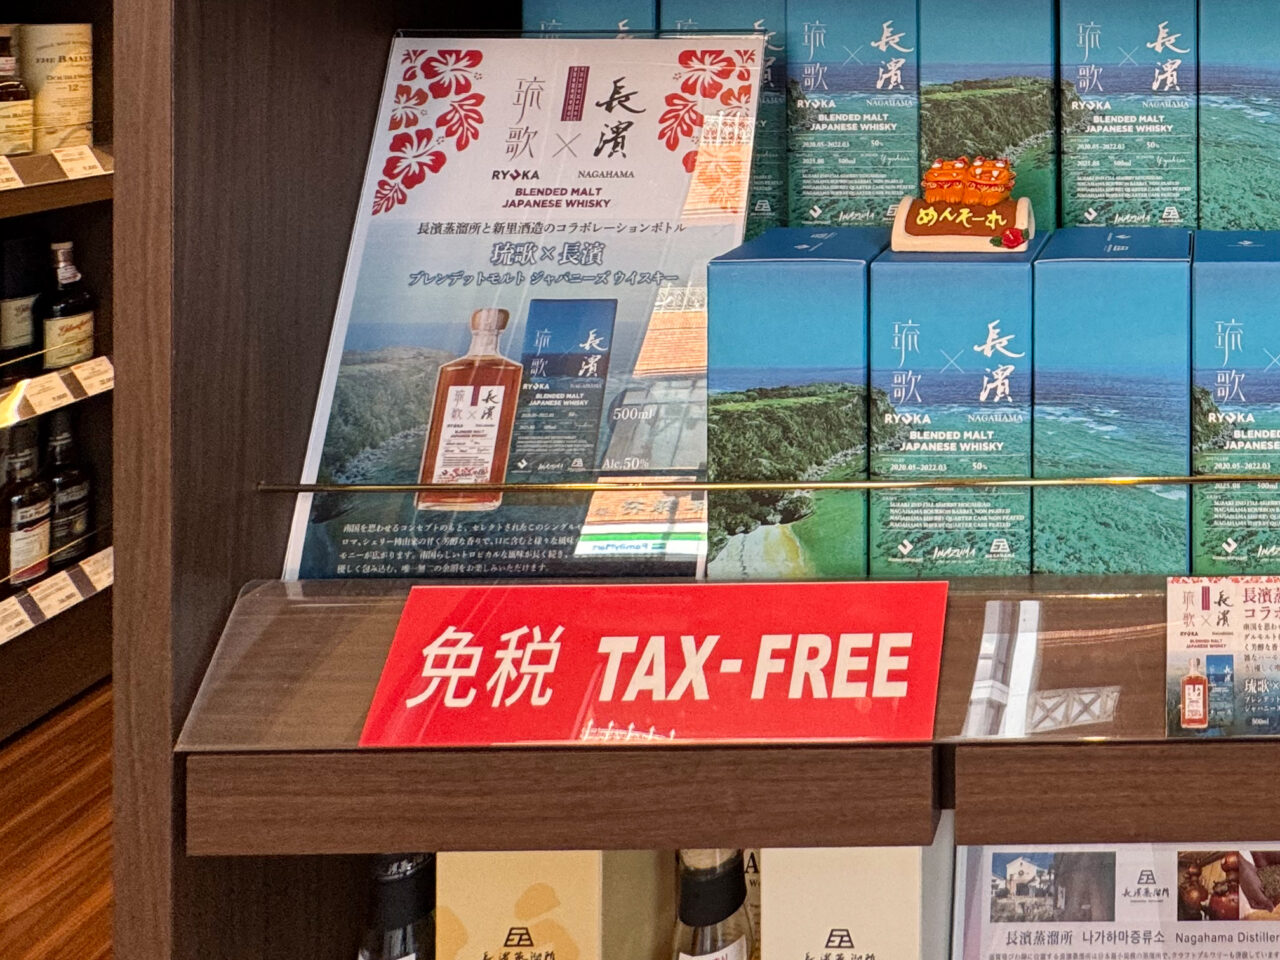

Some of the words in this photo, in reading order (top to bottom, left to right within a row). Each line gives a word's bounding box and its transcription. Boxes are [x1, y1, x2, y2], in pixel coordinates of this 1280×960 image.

[871, 19, 914, 91] 長濱
[1146, 20, 1190, 92] 長濱
[593, 76, 646, 160] 長濱
[1093, 115, 1137, 123] BLENDED
[1138, 114, 1165, 123] MALT
[1085, 125, 1133, 134] JAPANESE
[1136, 124, 1173, 132] WHISKY
[577, 170, 635, 179] NAGAHAMA
[515, 187, 569, 197] BLENDED
[571, 187, 603, 196] MALT
[501, 199, 562, 209] JAPANESE
[565, 199, 611, 209] WHISKY
[916, 206, 1007, 230] めんそーれ
[530, 271, 611, 286] ジャパニーズ
[614, 270, 680, 286] ウイスキー
[973, 319, 1025, 403] 長濱
[613, 408, 653, 420] 500ml
[909, 430, 961, 440] BLENDED
[963, 430, 994, 440] MALT
[899, 442, 957, 452] JAPANESE
[960, 442, 1004, 451] WHISKY
[406, 625, 564, 709] 免税
[597, 632, 912, 701] TAX-FREE
[1005, 929, 1073, 946] 長濱蒸溜所
[1082, 929, 1165, 945] 나가하마증류소
[1175, 932, 1234, 945] Nagahama
